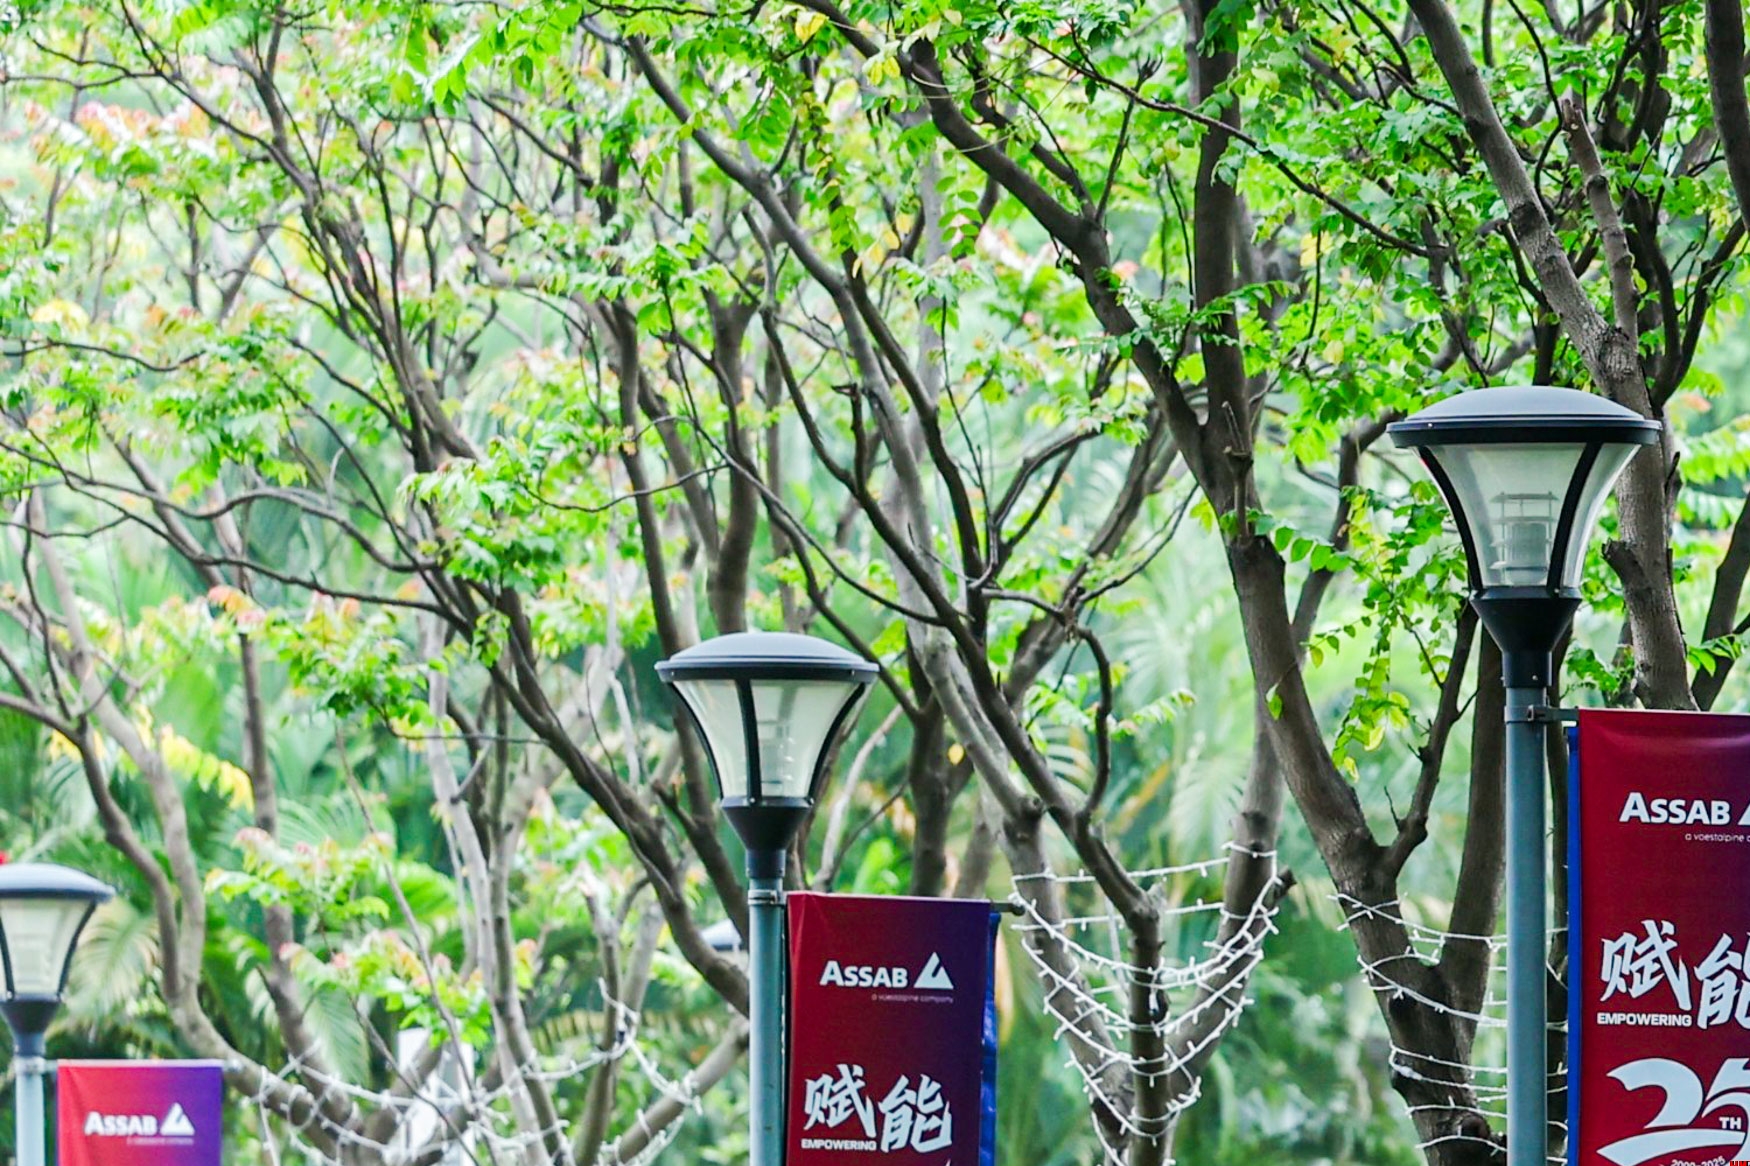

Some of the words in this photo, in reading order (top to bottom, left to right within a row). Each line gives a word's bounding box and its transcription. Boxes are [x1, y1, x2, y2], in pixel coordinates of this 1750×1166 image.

[1620, 791, 1730, 826] ASSAB
[1685, 833, 1692, 841] a
[1693, 832, 1745, 844] voestalpine
[820, 960, 908, 988] ASSAB
[1597, 1012, 1692, 1027] EMPOWERING
[803, 1063, 953, 1154] 赋能
[84, 1111, 158, 1136] ASSAB
[1719, 1117, 1742, 1130] TH
[801, 1138, 877, 1151] EMPOWERING
